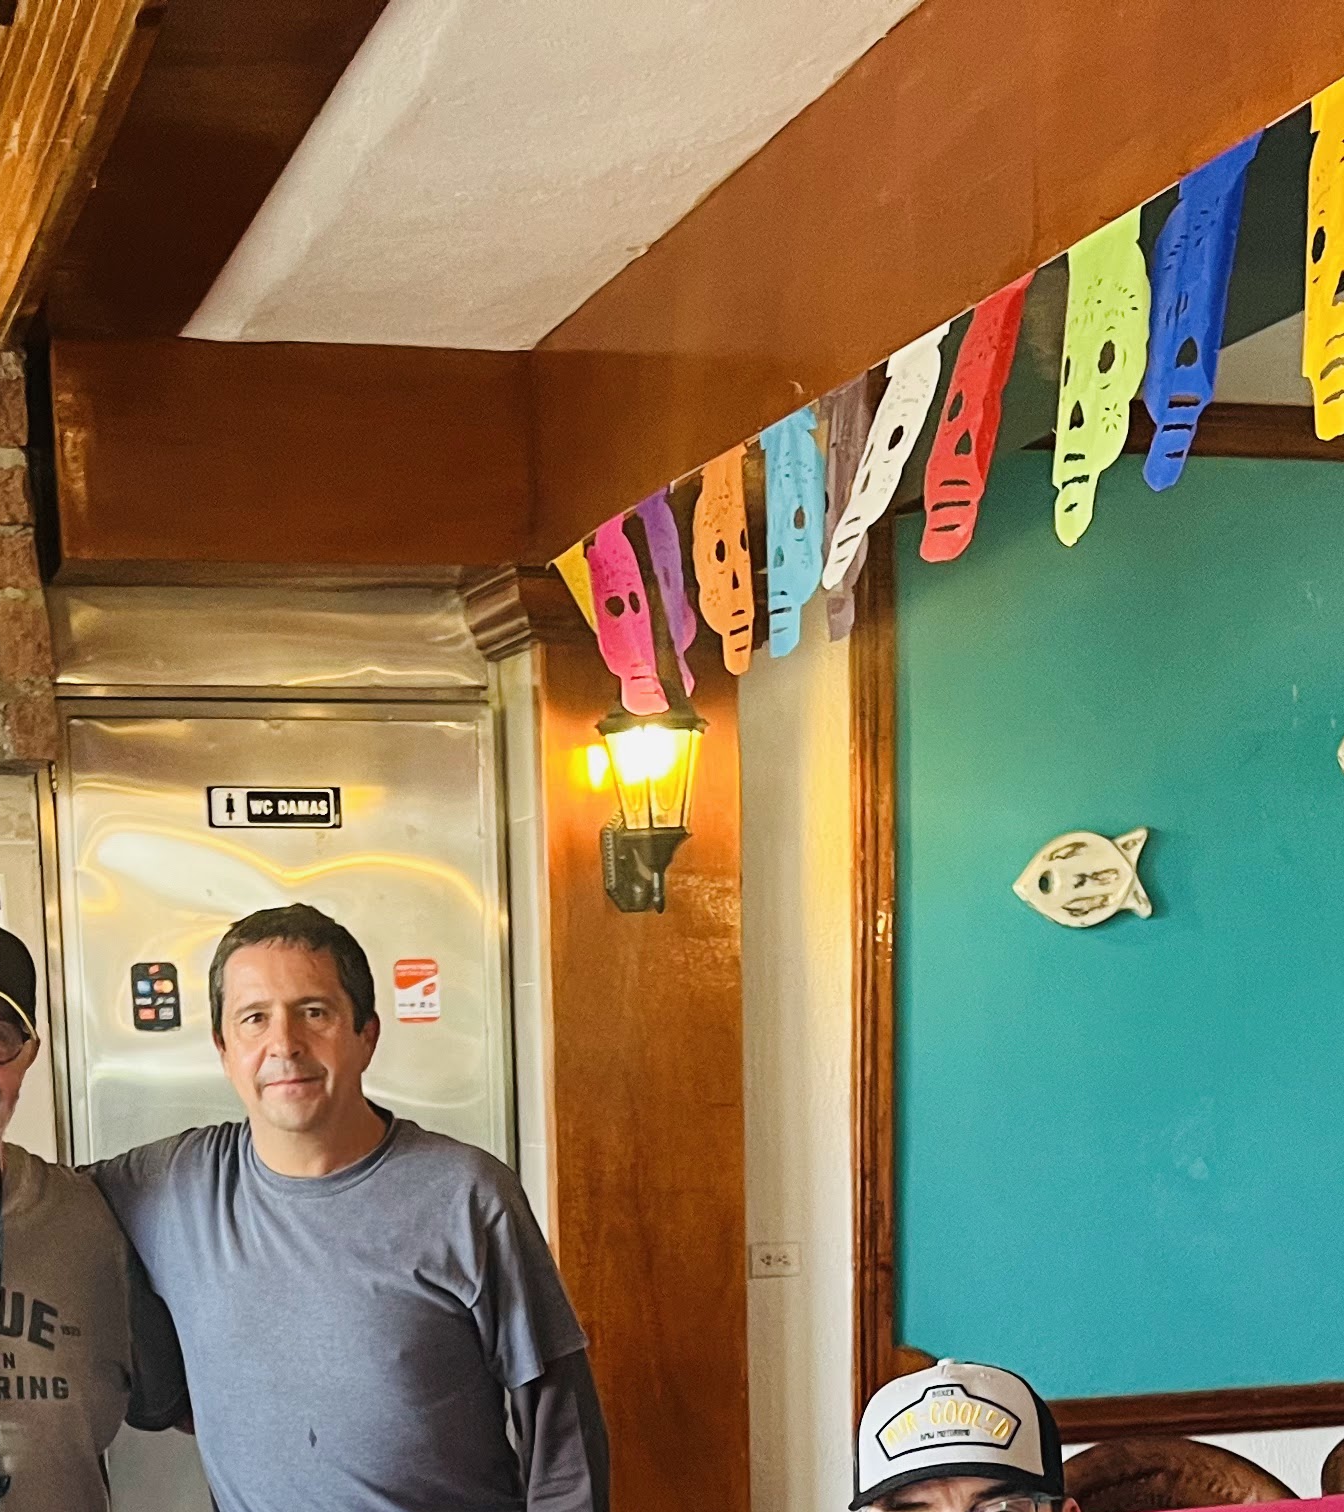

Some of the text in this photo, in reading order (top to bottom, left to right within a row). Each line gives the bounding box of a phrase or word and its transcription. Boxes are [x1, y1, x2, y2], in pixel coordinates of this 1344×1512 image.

[249, 799, 328, 816] WC DAMAS
[920, 1432, 934, 1441] BMW
